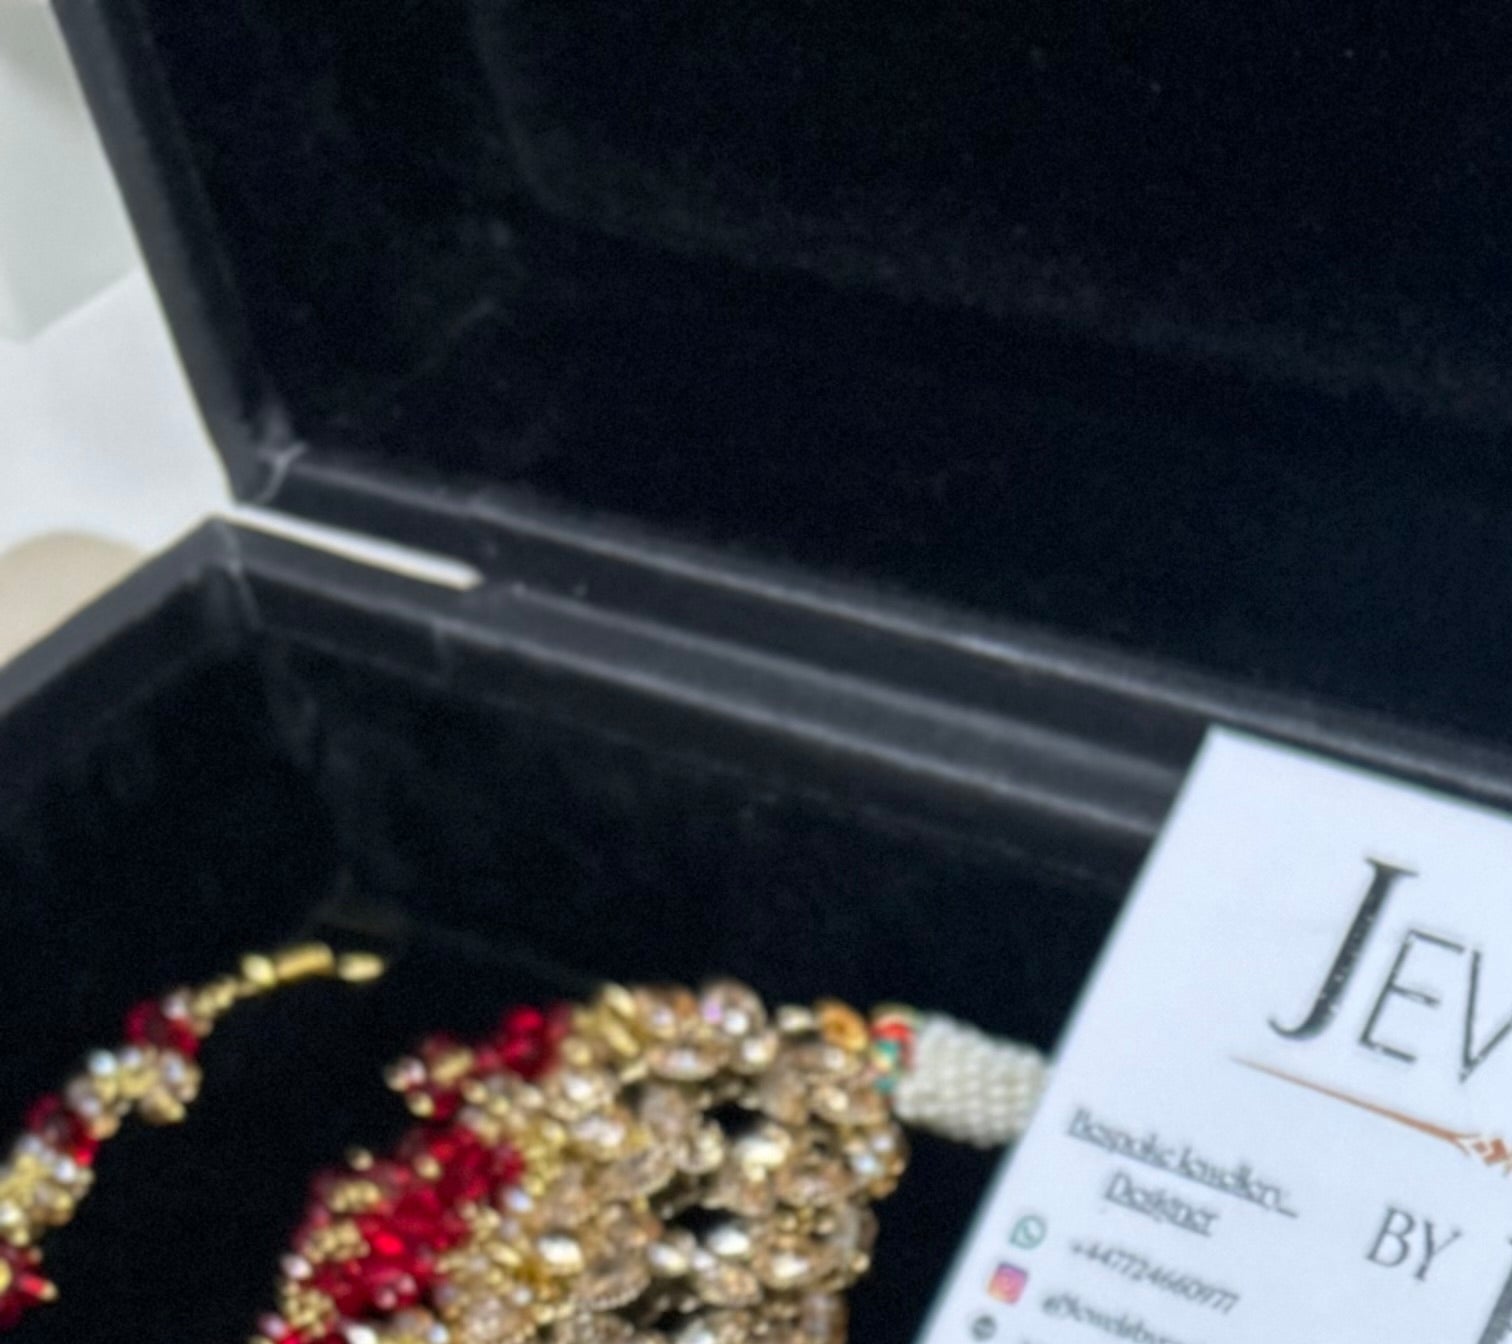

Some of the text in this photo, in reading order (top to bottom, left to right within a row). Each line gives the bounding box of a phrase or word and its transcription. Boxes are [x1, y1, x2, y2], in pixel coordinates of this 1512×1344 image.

[1068, 1107, 1173, 1169] Bespoke
[1104, 1170, 1219, 1236] Designer
[1366, 1206, 1463, 1282] BY
